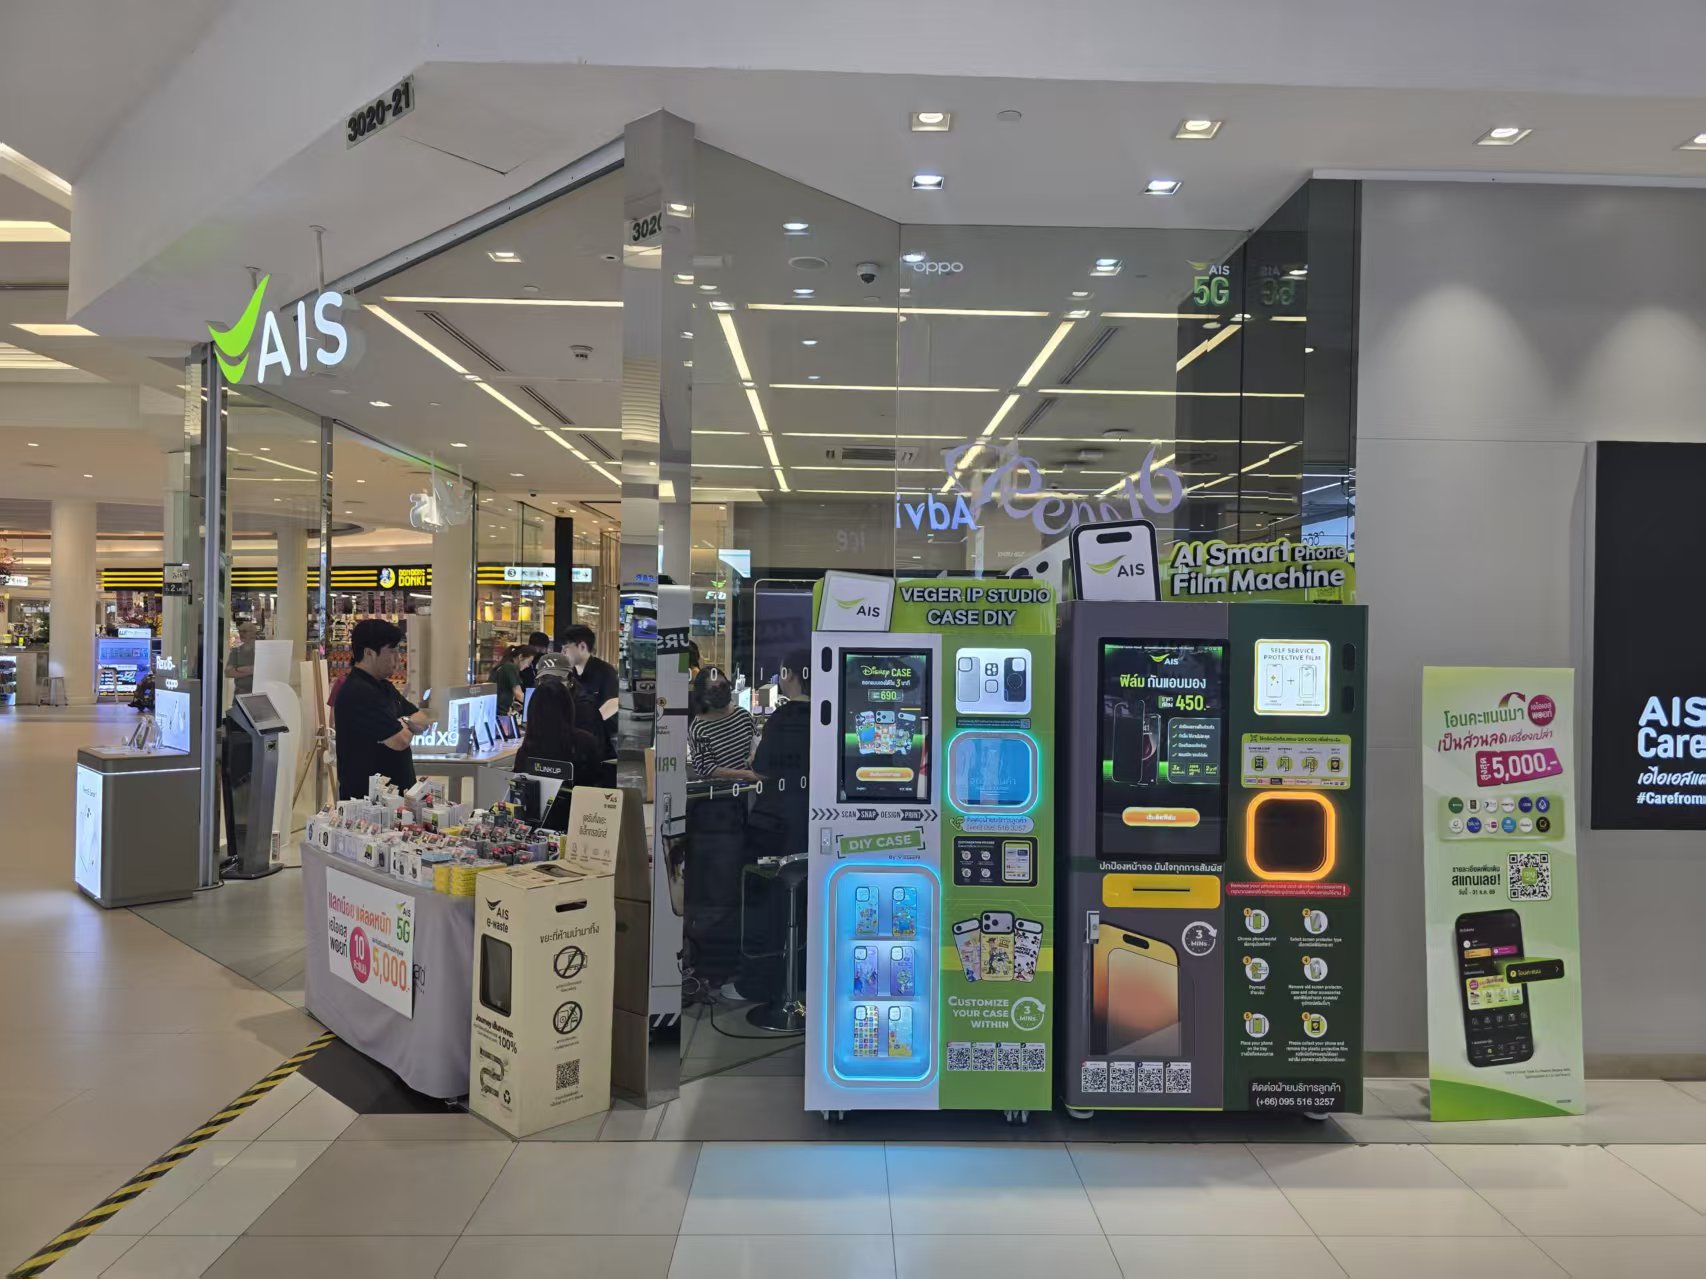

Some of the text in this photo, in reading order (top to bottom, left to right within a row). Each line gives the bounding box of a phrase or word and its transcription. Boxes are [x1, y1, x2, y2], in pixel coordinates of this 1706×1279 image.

[347, 81, 410, 142] 3020-21
[914, 262, 963, 275] oppo
[1208, 265, 1230, 275] AIS
[1194, 276, 1229, 305] 5G
[257, 291, 348, 384] AIS
[1174, 541, 1346, 567] AI Smart Phone
[1117, 563, 1146, 577] AIS
[398, 575, 425, 586] DONKI
[1173, 565, 1345, 595] Film Machine
[901, 588, 1051, 603] VEGER IP STUDIO
[856, 605, 880, 617] AIS
[927, 610, 1016, 625] CASE DIY
[860, 665, 912, 678] Disney CASE
[1119, 673, 1207, 689] ฟิล์ม กันแอบมอง
[1443, 707, 1524, 728] โอนคะแนนมา
[1638, 696, 1706, 727] AIS
[1637, 726, 1706, 758] Care
[1491, 752, 1558, 782] 5,000.-
[861, 810, 876, 818] SNAP
[849, 834, 912, 850] DIY CASE
[1099, 861, 1153, 871] ปกป้องหน้าจอ
[1451, 874, 1501, 886] สแกนเลย!
[496, 907, 509, 920] AIS
[396, 916, 410, 943] 5G
[486, 918, 509, 933] e-waste
[539, 922, 600, 943] ขยะที่ห้ามนำมาทิ้ง
[1195, 929, 1203, 939] 3
[354, 934, 365, 961] 10
[948, 996, 1009, 1007] CUSTOMIZE
[982, 1010, 1009, 1018] CASE
[1023, 1006, 1031, 1014] 3
[971, 1020, 1009, 1028] WITHIN
[498, 1035, 518, 1054] 100%
[1251, 1082, 1341, 1095] ติดต่อฝ่ายบริการลูกค้า
[1256, 1097, 1335, 1107] (+66) 095 516 3257
